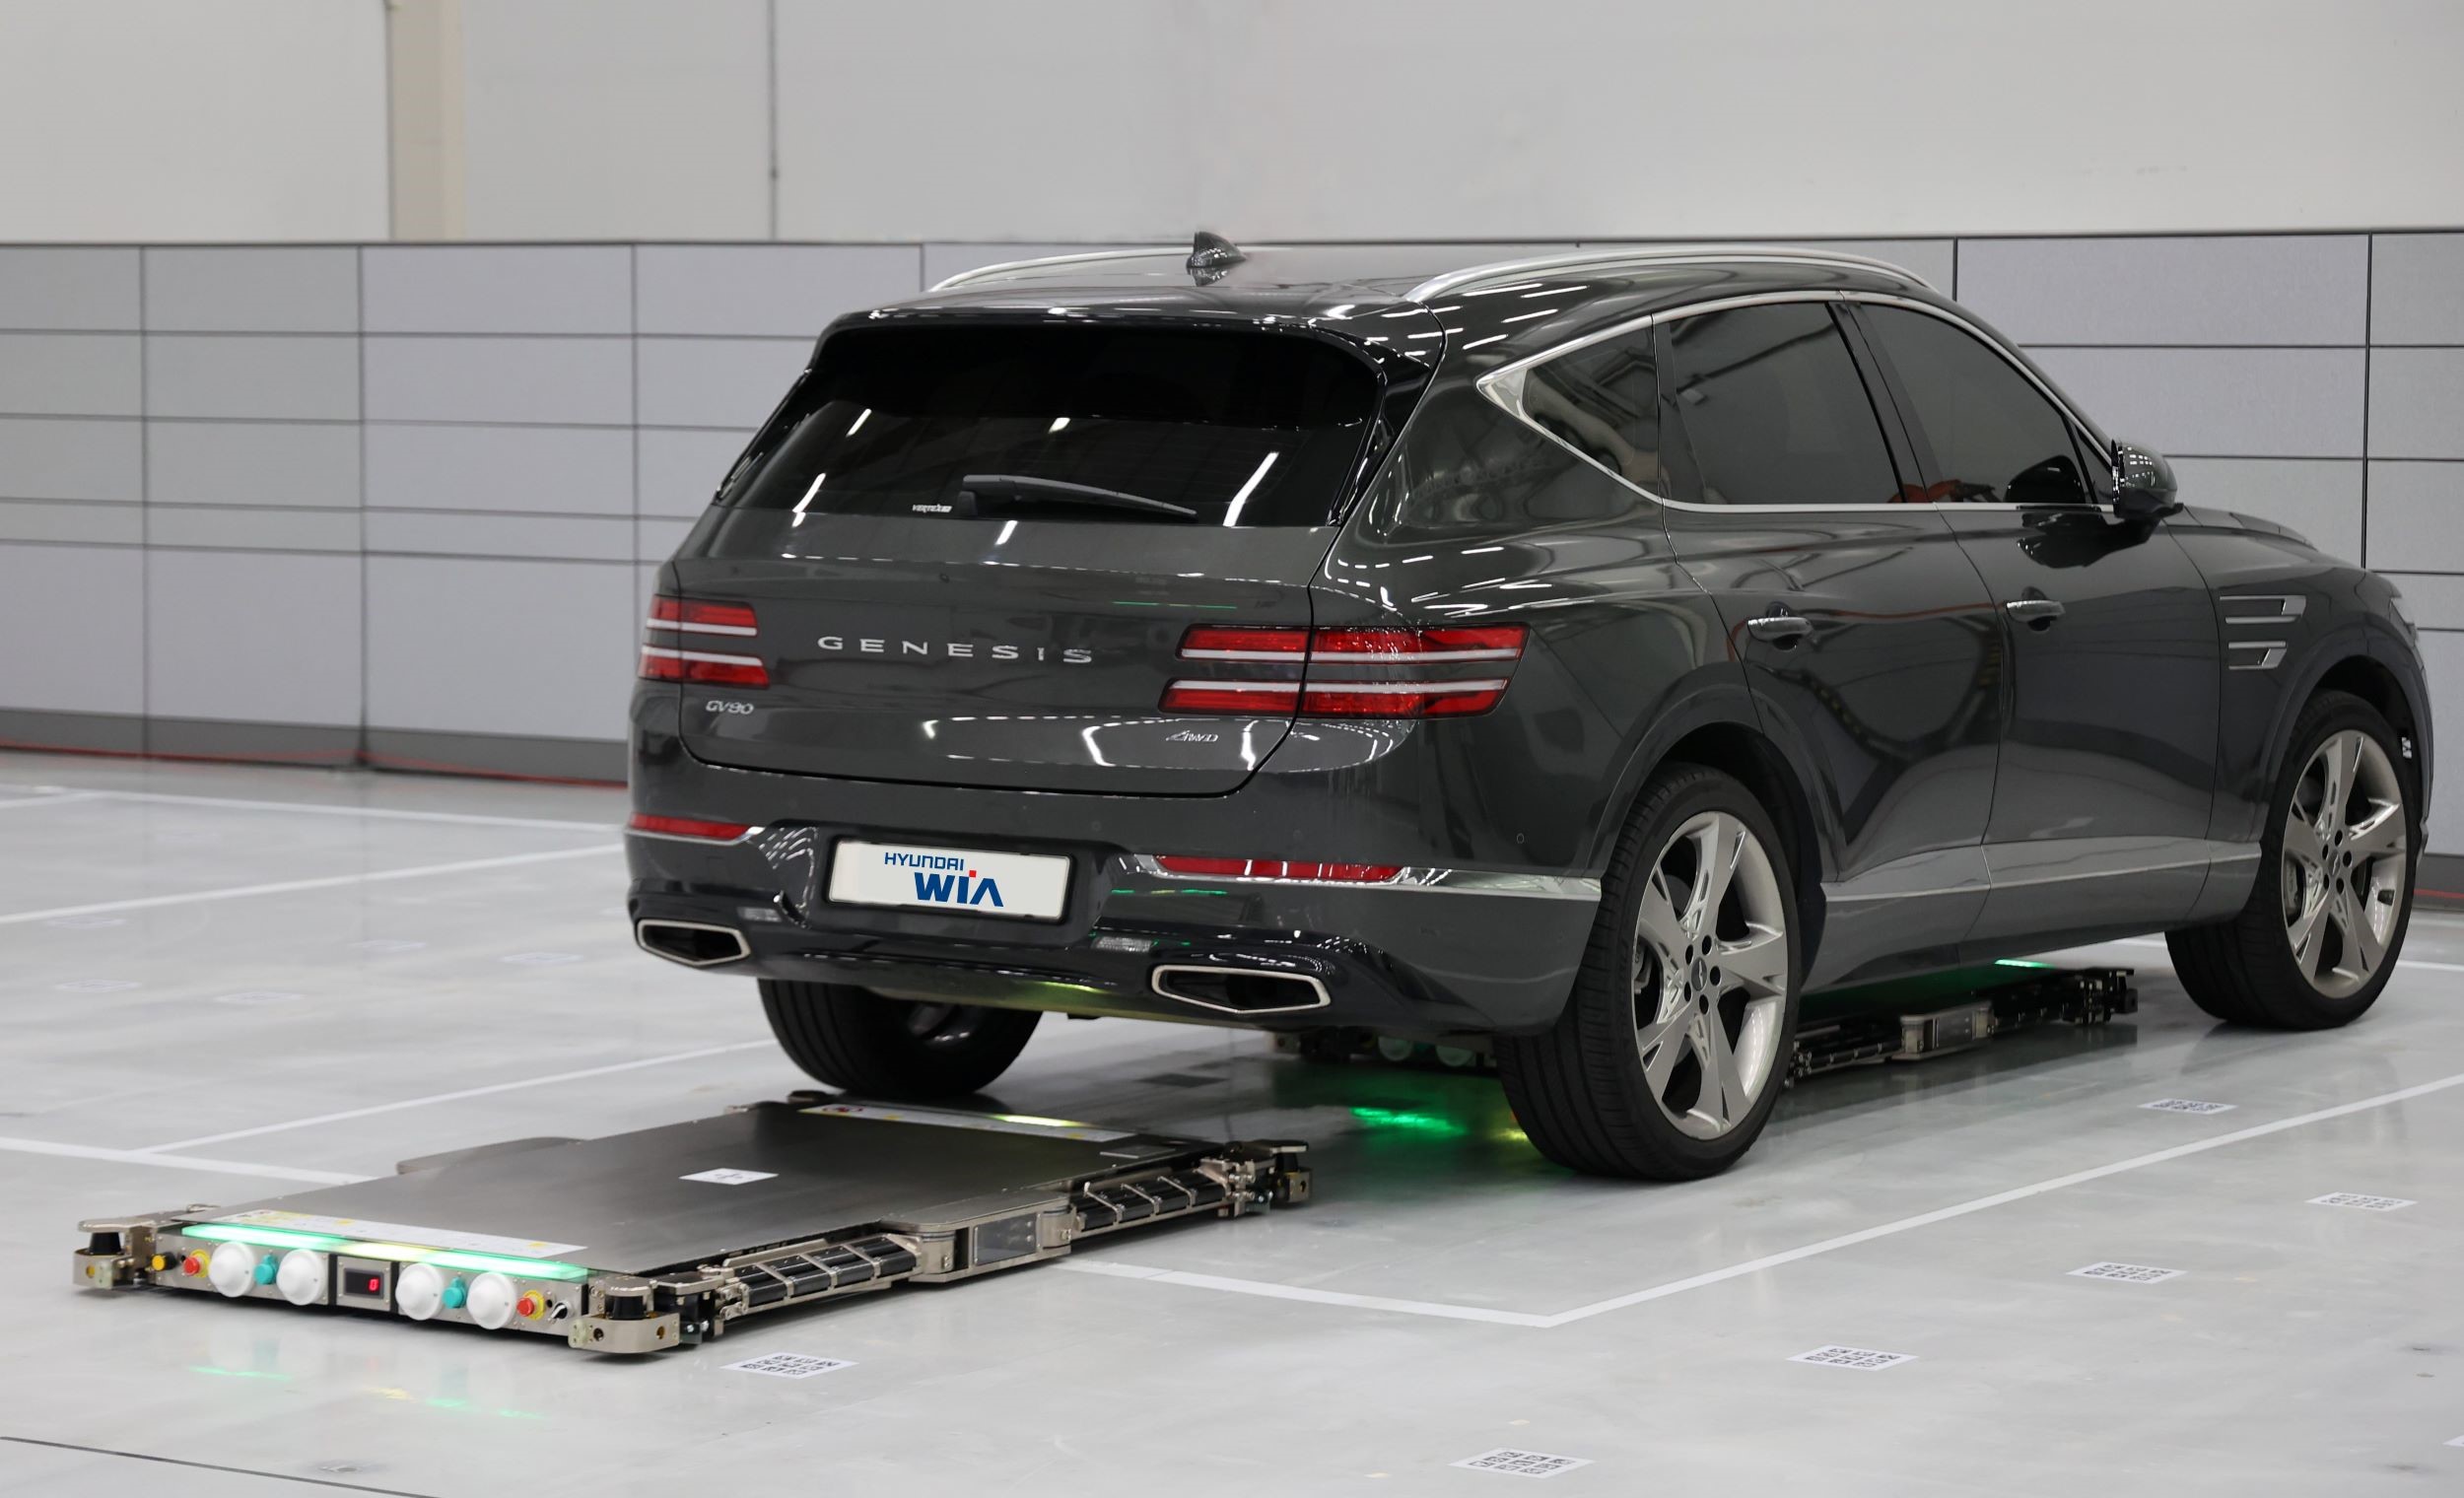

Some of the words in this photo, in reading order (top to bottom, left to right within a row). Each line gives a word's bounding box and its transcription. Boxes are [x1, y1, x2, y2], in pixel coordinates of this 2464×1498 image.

[817, 636, 1092, 663] GENESIS
[884, 851, 964, 871] HYUNDAI
[914, 869, 1004, 908] WIA
